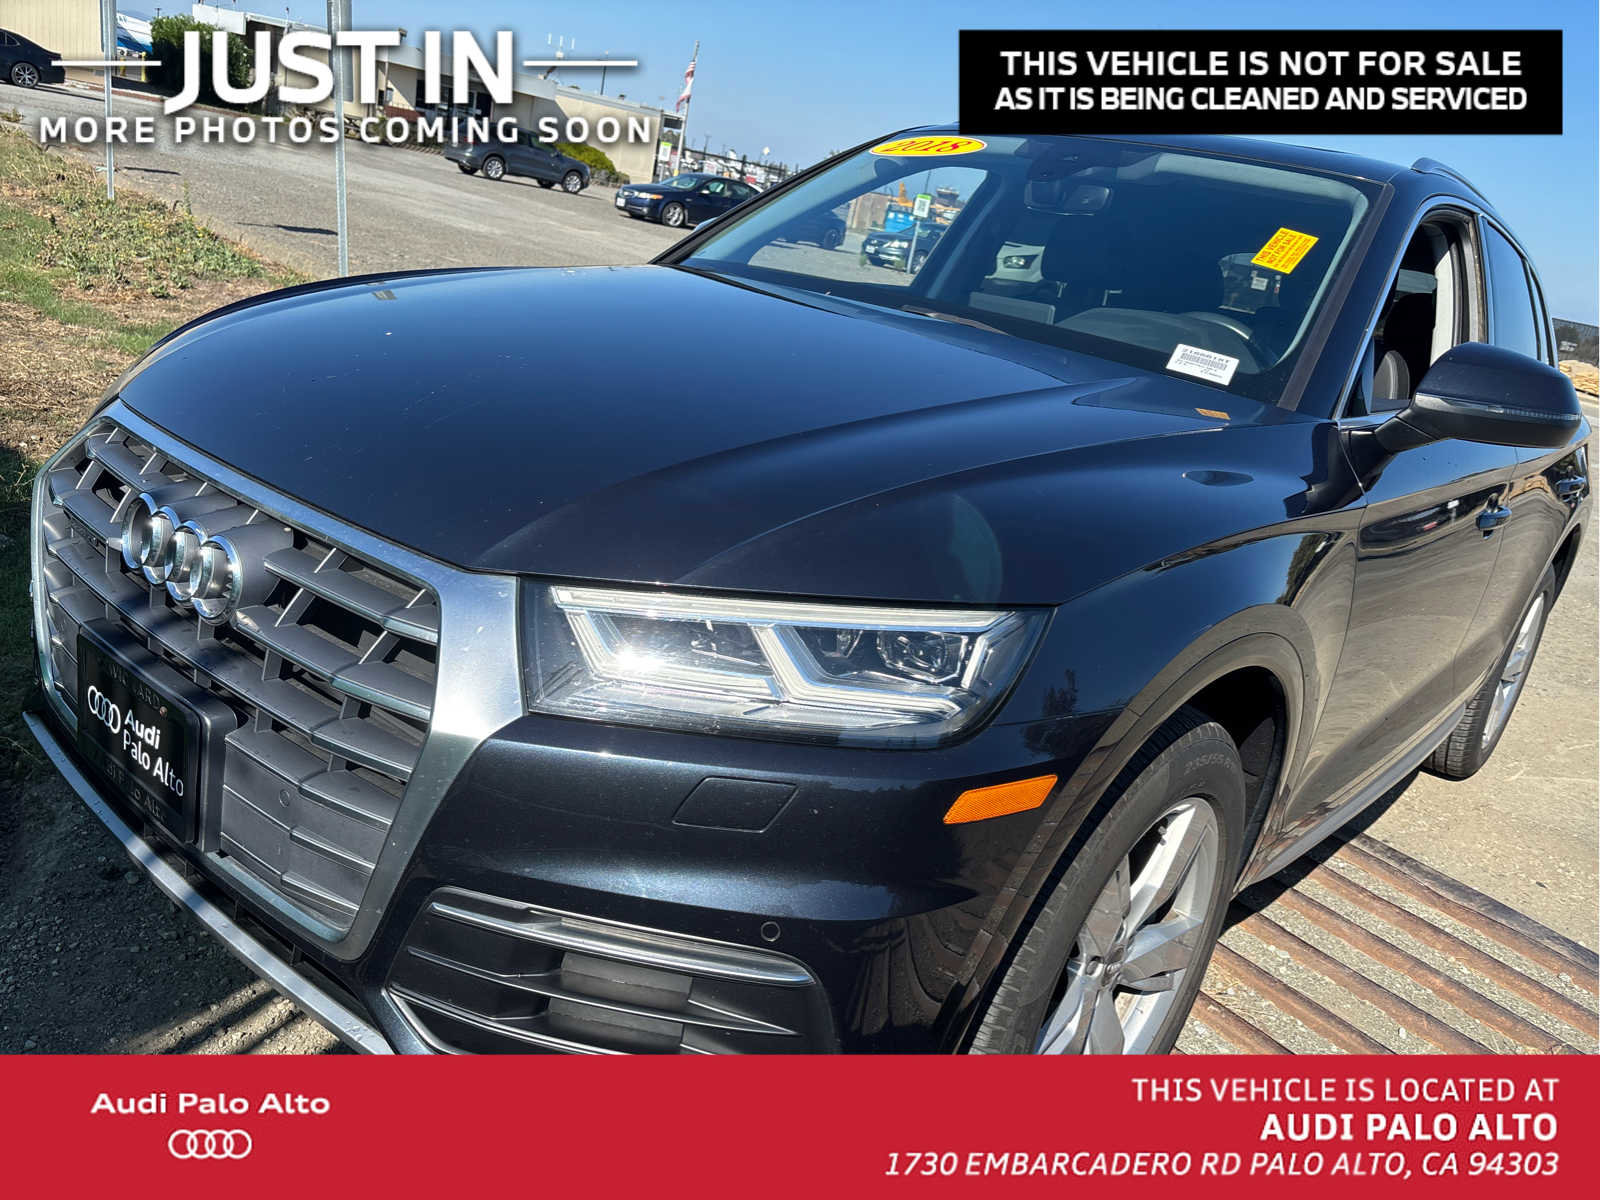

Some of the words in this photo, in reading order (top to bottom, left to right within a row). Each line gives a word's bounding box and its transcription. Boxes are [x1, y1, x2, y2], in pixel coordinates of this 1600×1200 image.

[880, 140, 973, 153] 2018
[124, 710, 161, 750] Audi
[123, 729, 150, 771] Palo
[153, 757, 184, 797] Alto
